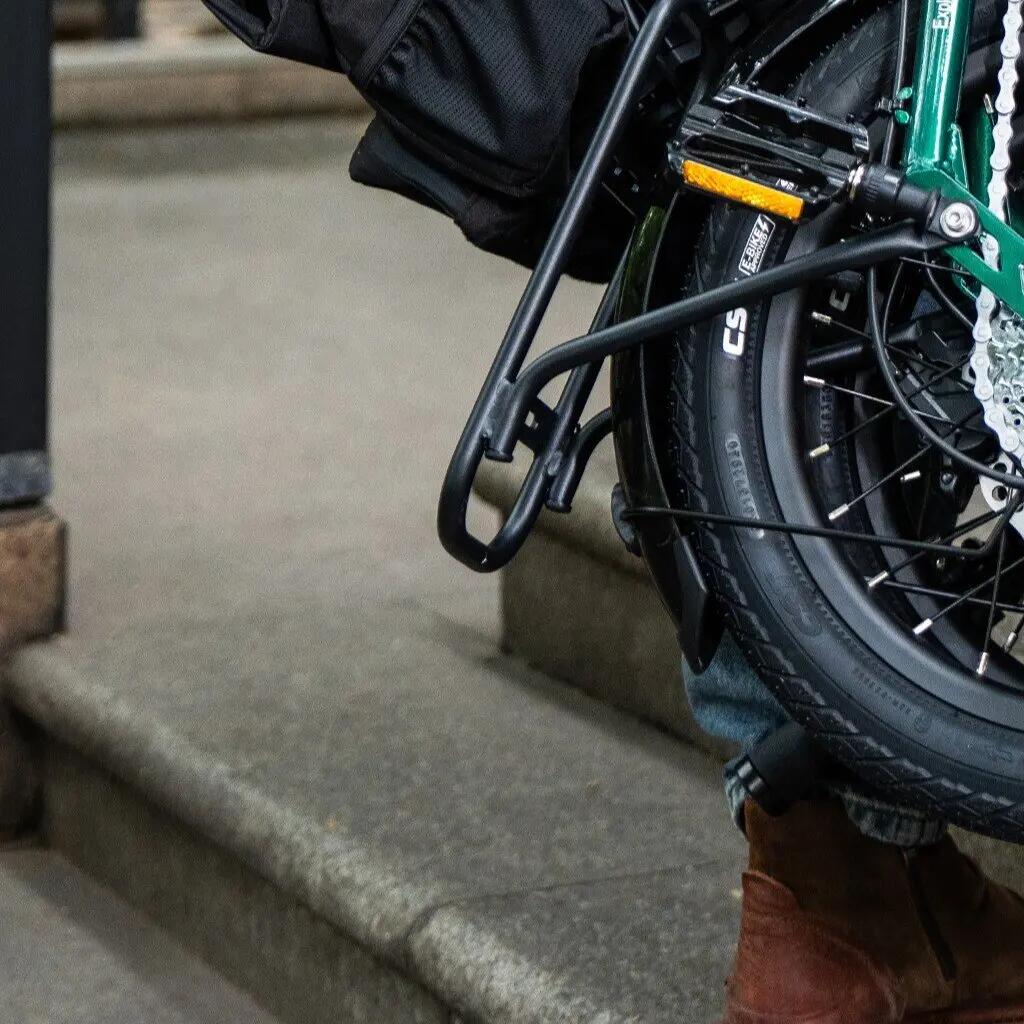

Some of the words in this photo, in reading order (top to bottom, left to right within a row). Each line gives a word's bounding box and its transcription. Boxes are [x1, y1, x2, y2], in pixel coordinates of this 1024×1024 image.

[742, 226, 763, 271] E-BIKE
[750, 233, 768, 274] APPROVED
[722, 307, 748, 356] CS
